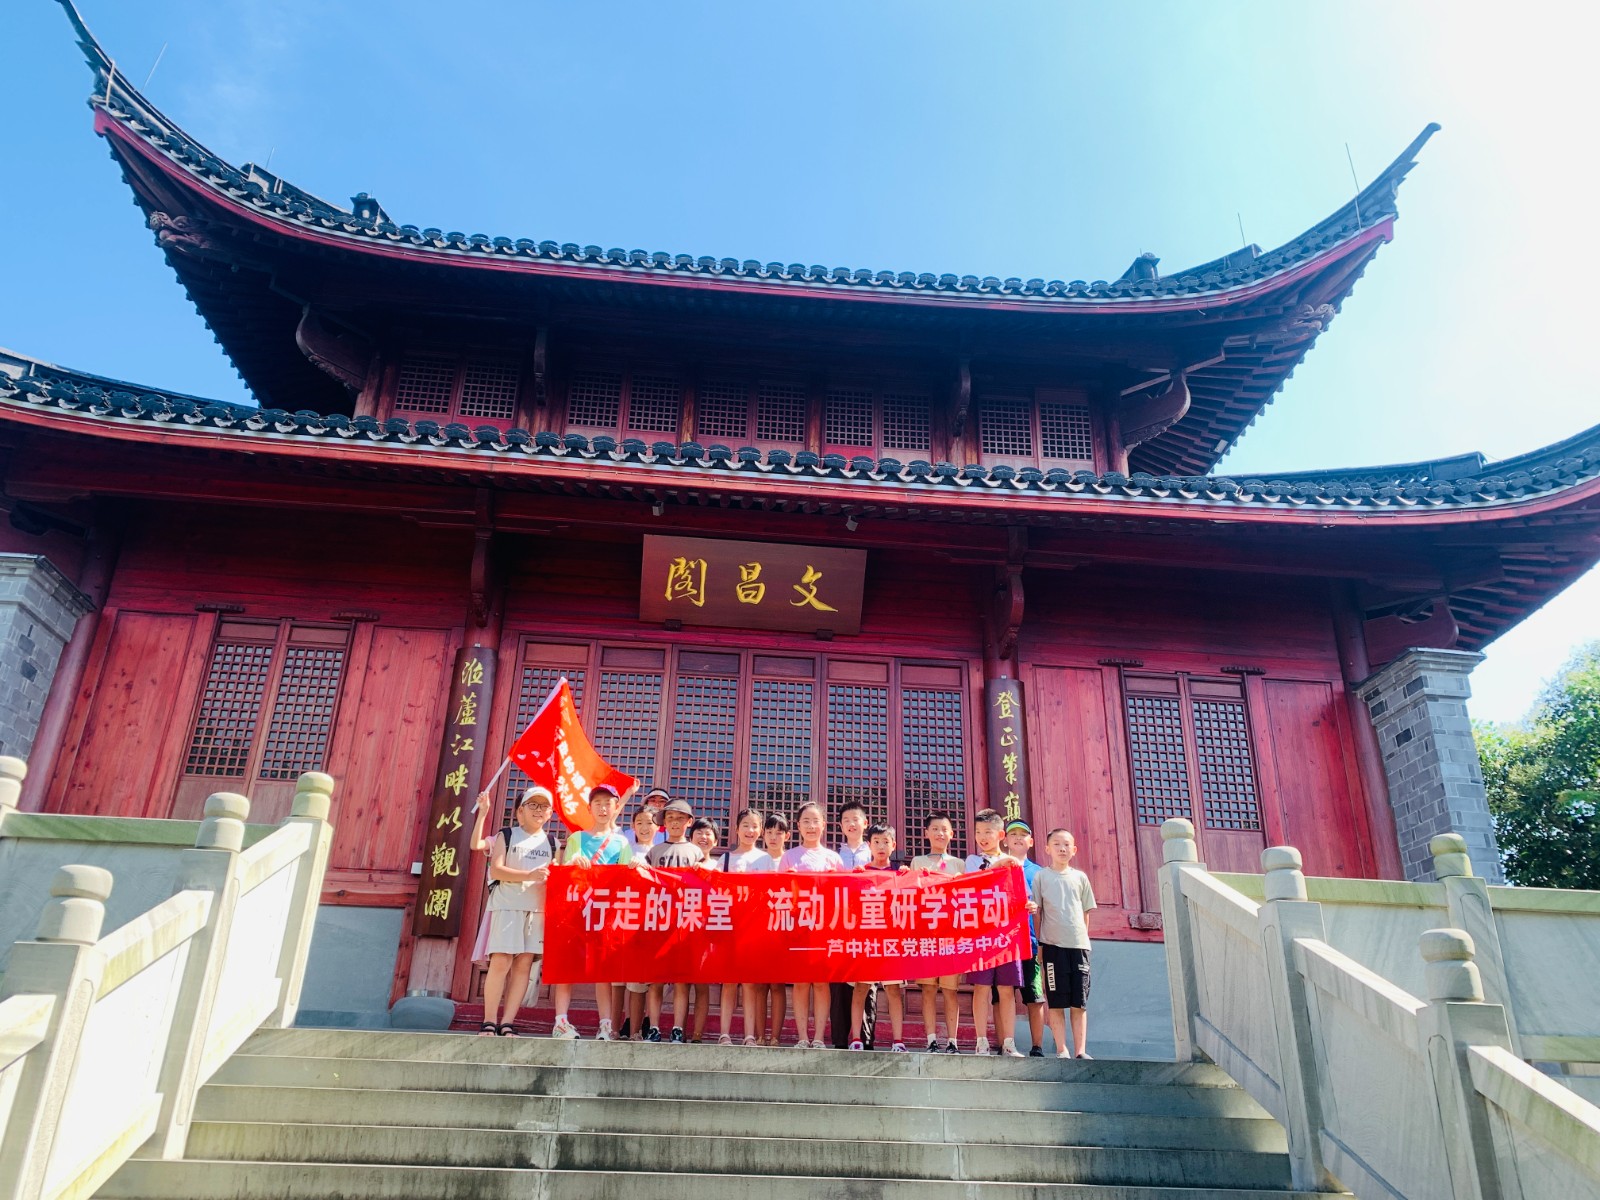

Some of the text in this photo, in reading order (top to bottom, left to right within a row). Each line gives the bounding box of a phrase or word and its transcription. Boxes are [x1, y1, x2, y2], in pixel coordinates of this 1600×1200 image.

[566, 884, 1010, 932] “行走的课堂” 流动儿童研学活动
